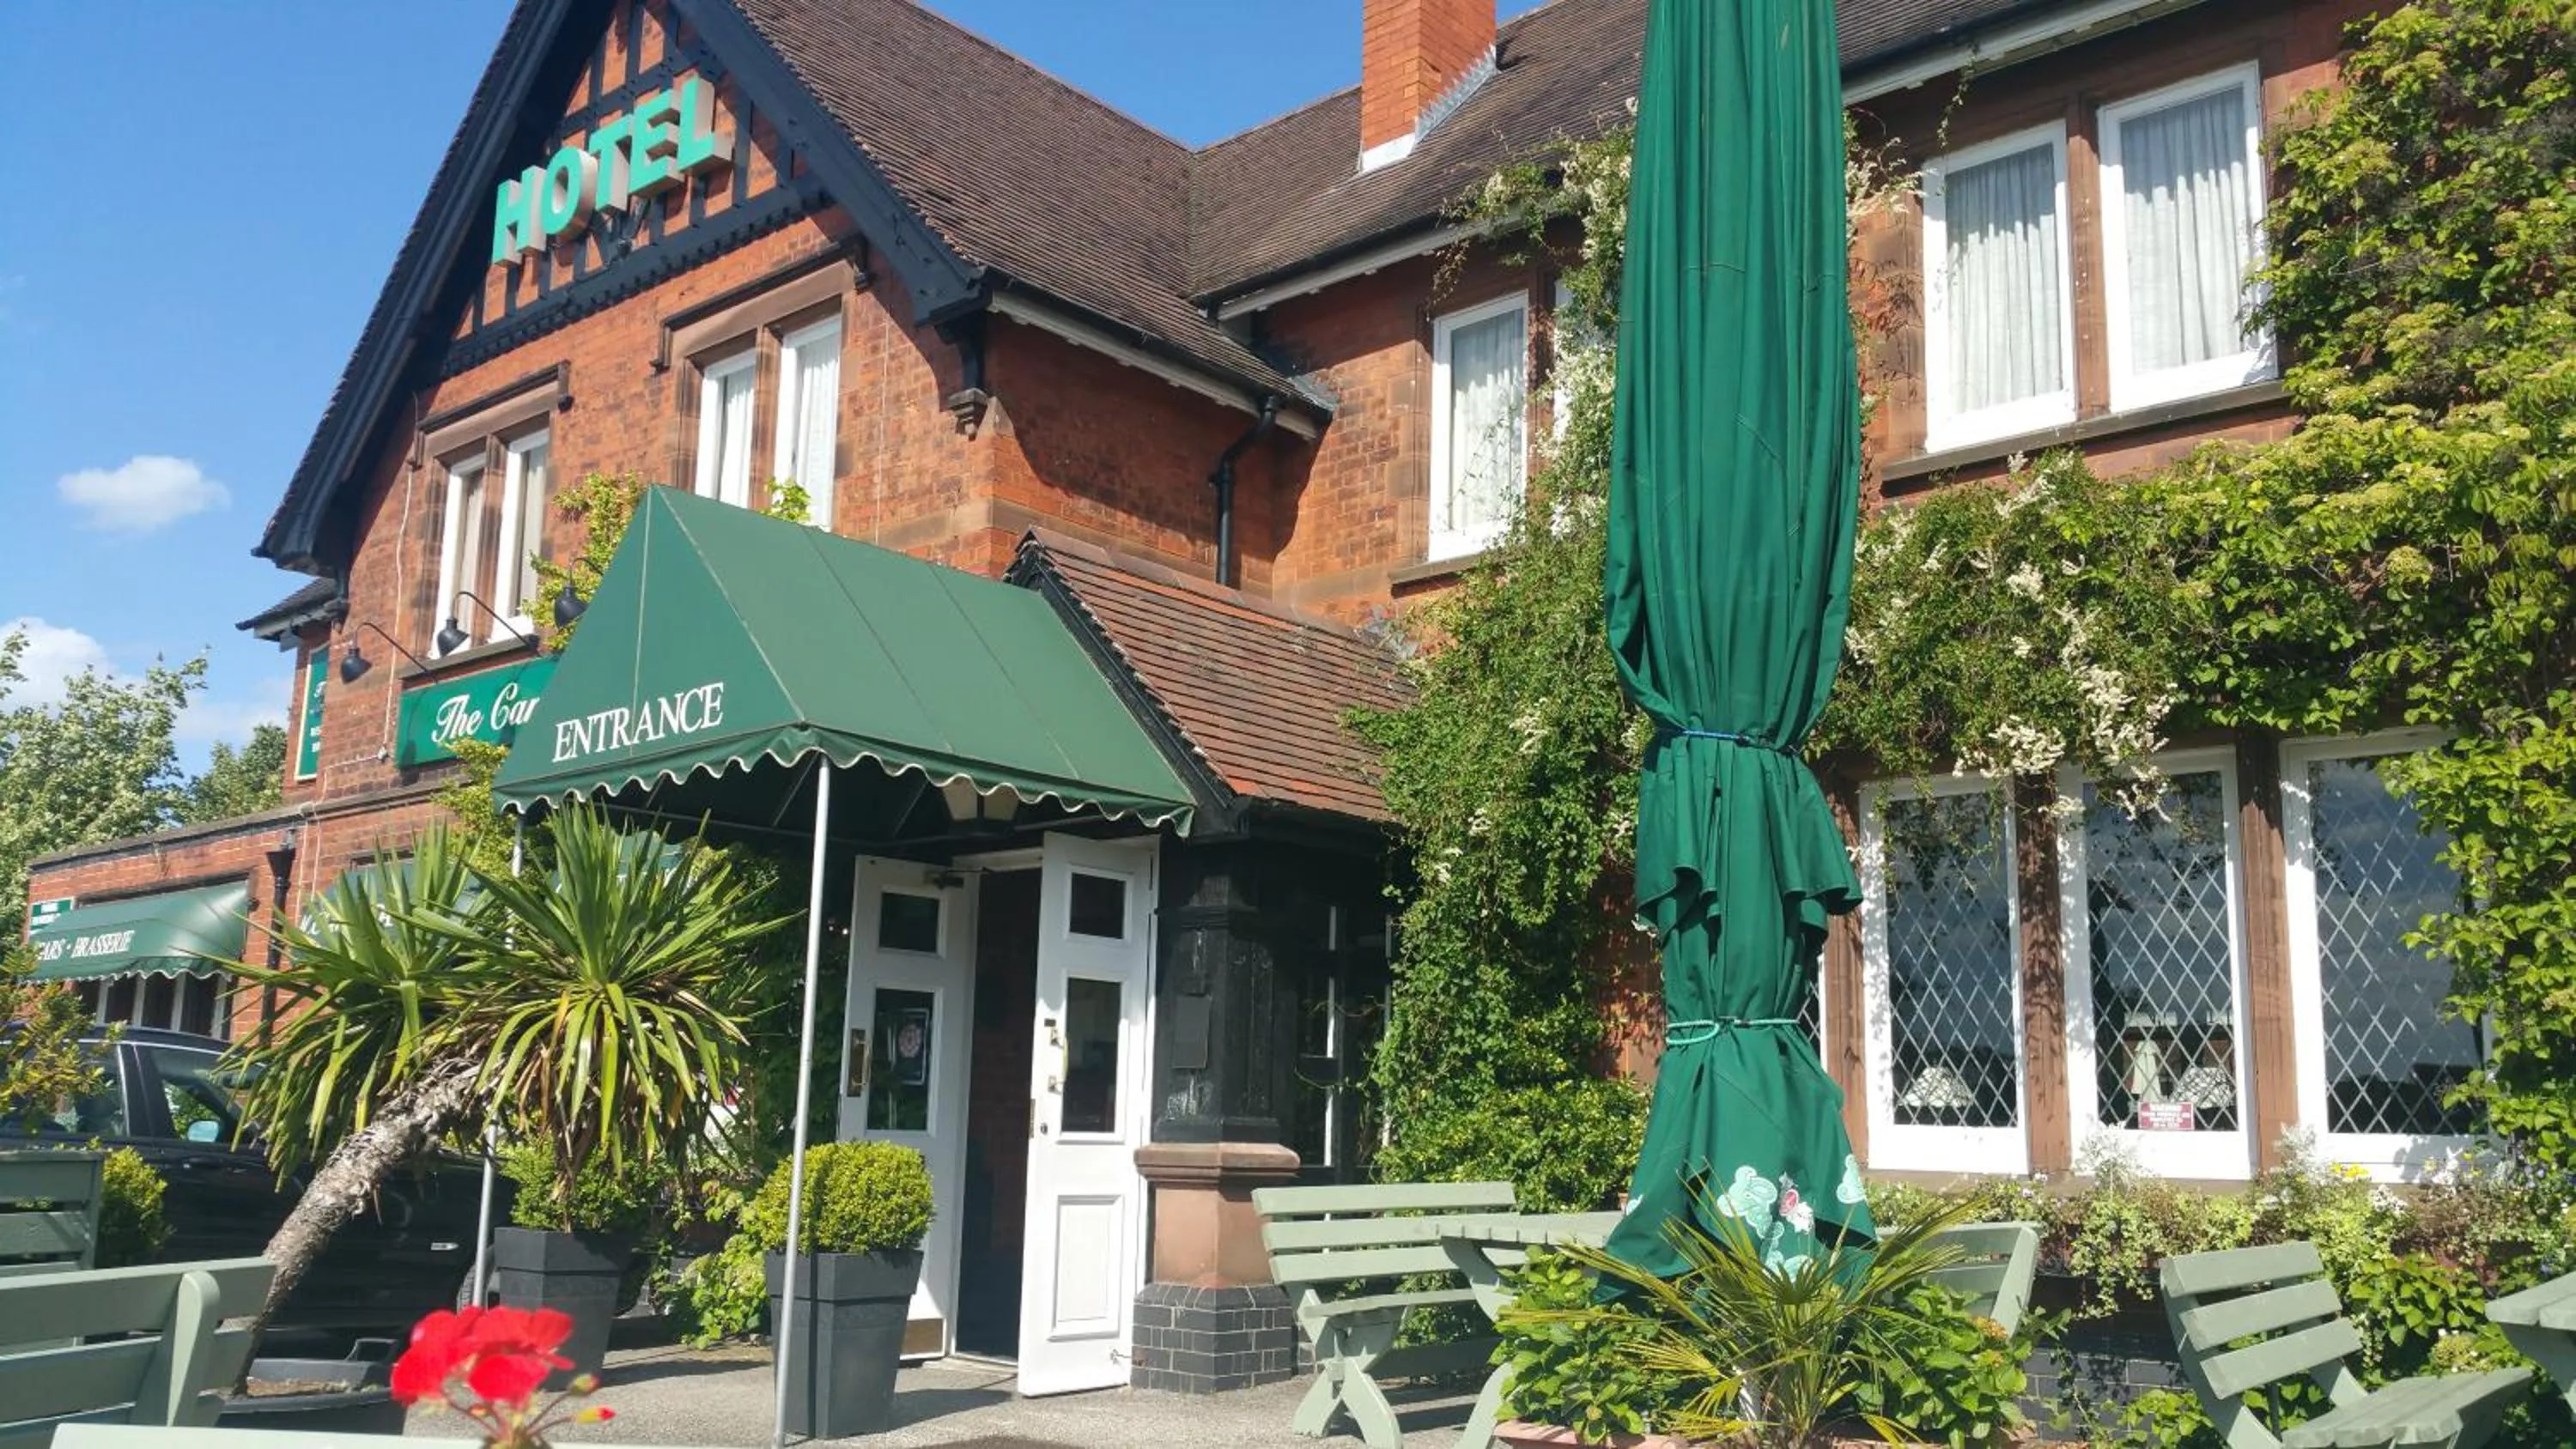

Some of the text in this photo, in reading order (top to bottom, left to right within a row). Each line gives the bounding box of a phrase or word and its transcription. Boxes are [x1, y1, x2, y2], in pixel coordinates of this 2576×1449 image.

[493, 75, 728, 264] HOTEL
[431, 694, 483, 743] The
[552, 682, 724, 763] ENTRANCE
